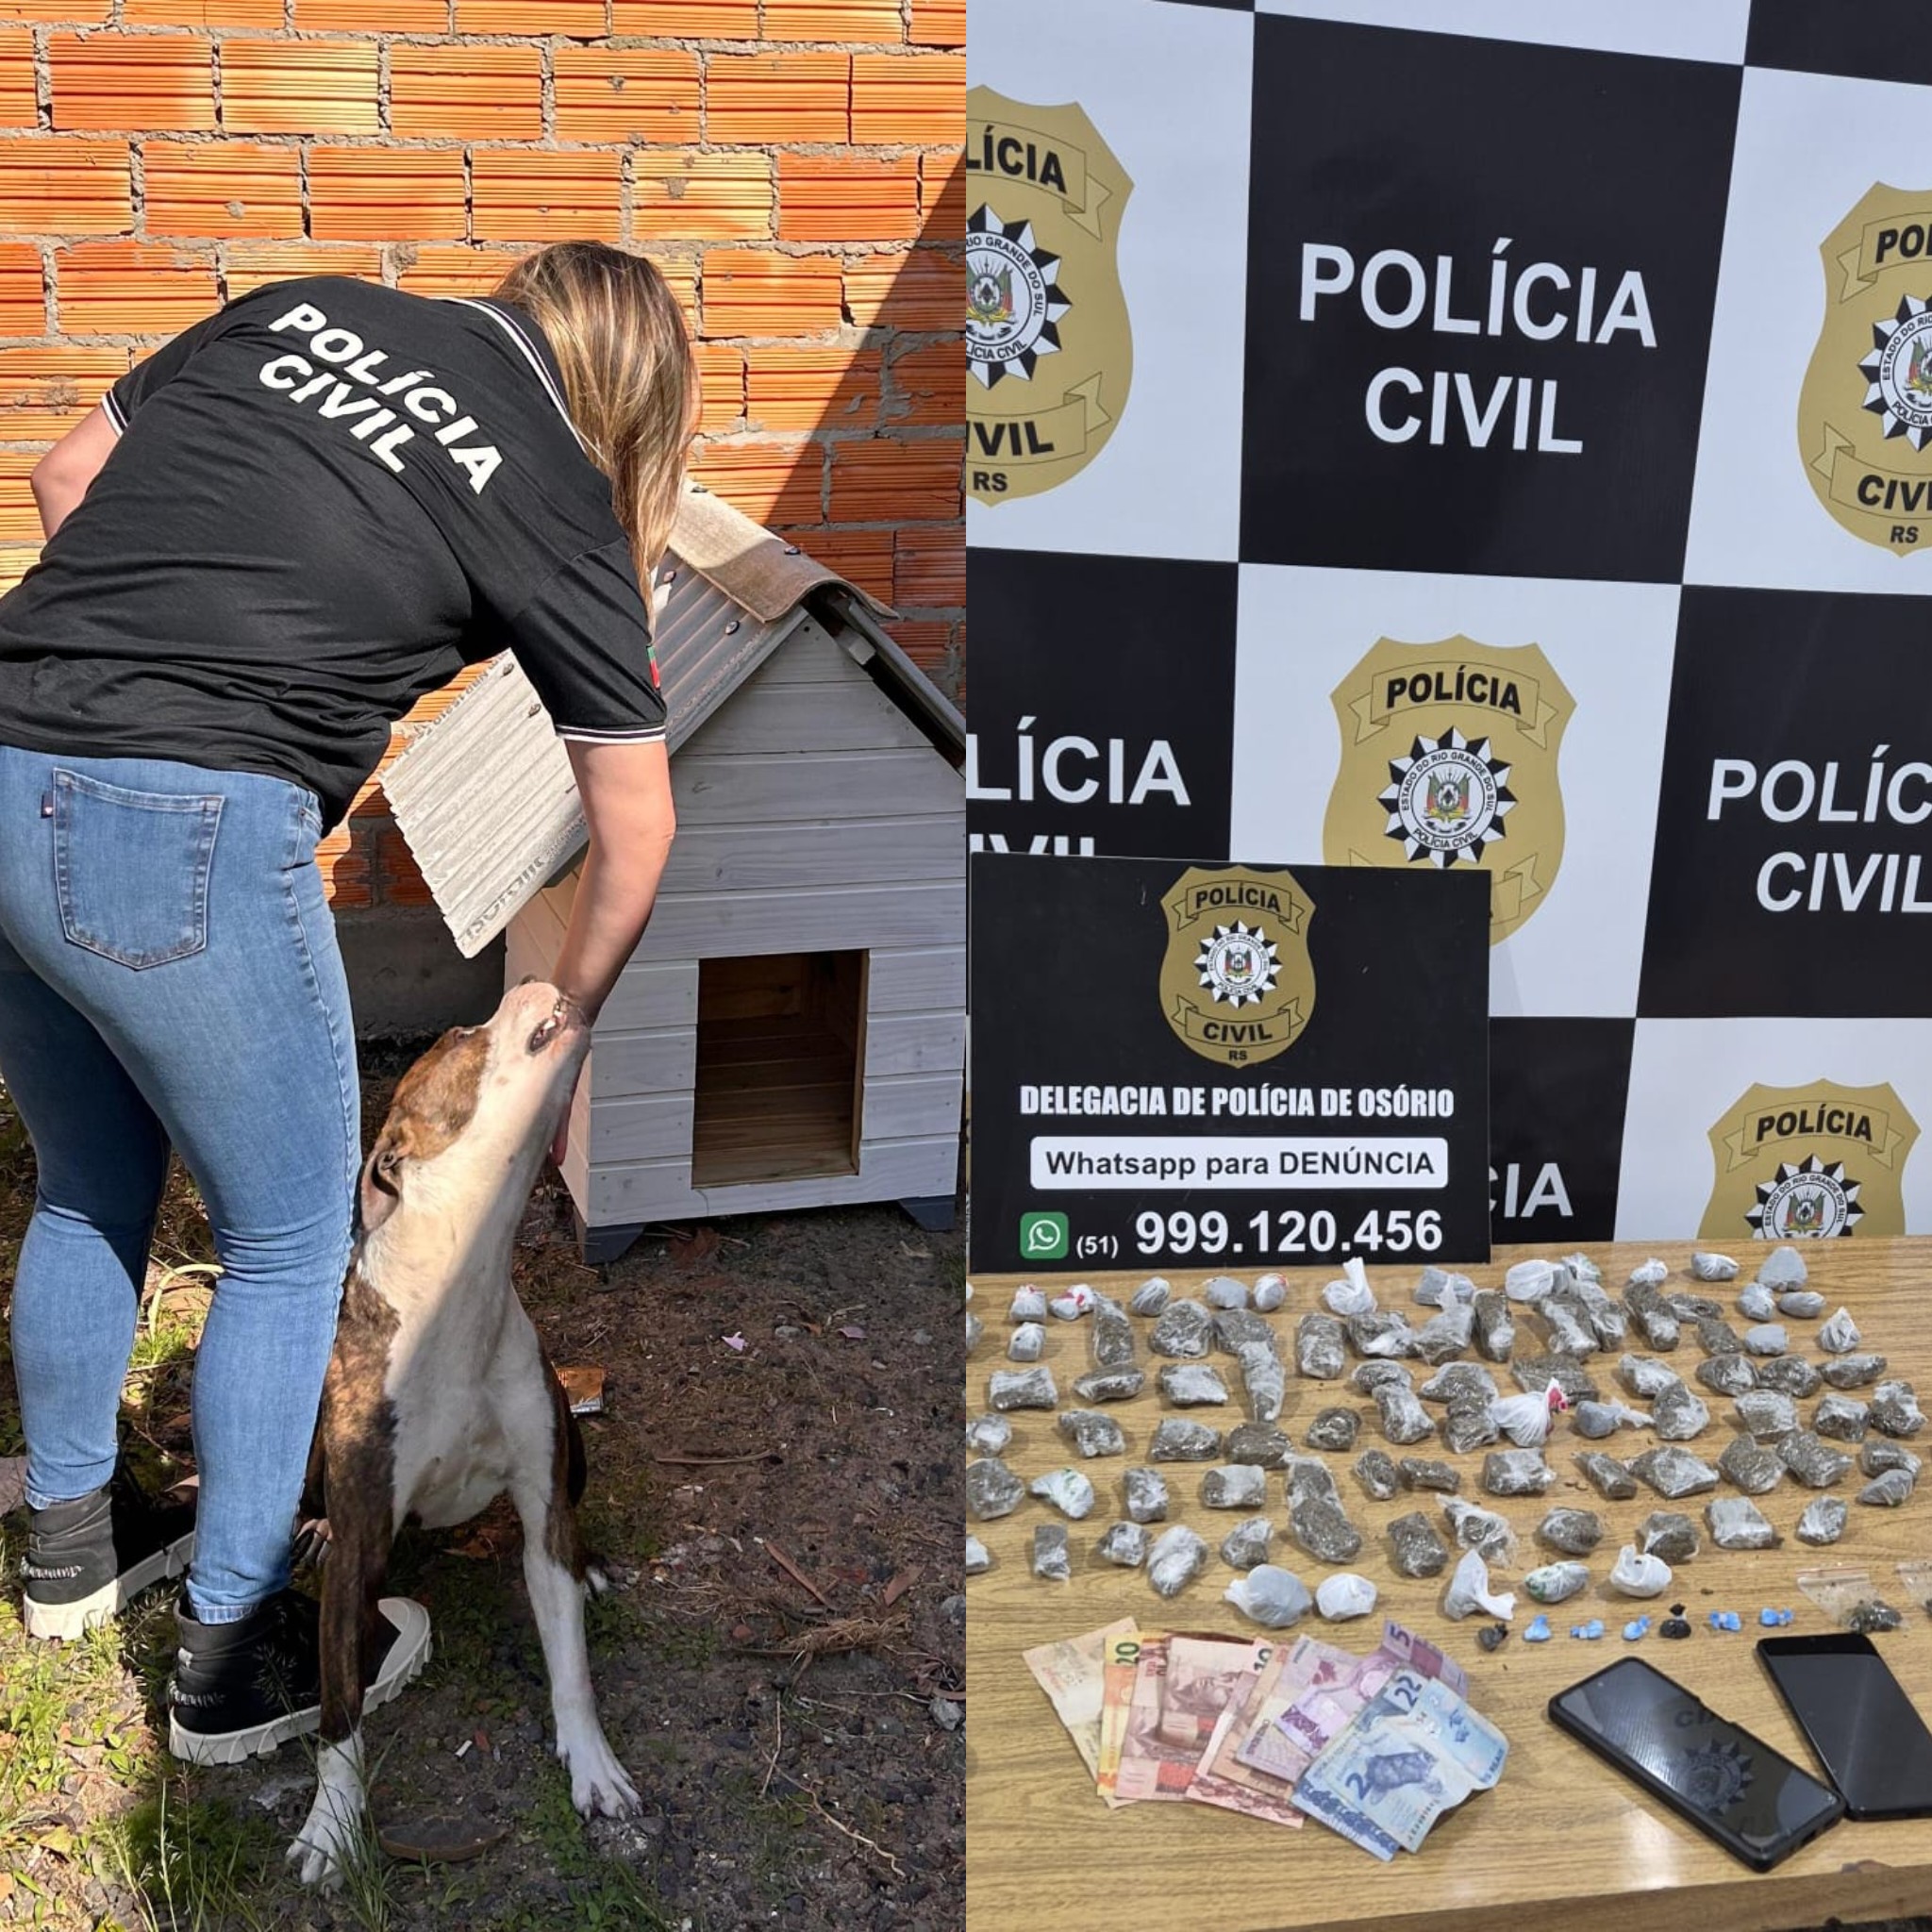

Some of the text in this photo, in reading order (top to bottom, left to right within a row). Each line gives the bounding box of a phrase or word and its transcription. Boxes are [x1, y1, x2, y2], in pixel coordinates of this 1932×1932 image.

[966, 124, 1067, 194] LÍCIA
[986, 237, 1031, 269] GRANDE
[1028, 271, 1040, 289] DO
[1034, 293, 1043, 316] SUL
[1300, 237, 1657, 348] POLÍCIA
[997, 341, 1027, 358] CIVIL
[1882, 337, 1901, 381] ESTADO
[1900, 323, 1916, 337] DO
[259, 354, 415, 473] CIVIL
[268, 302, 503, 495] POLÍCIA
[1365, 367, 1584, 454] CIVIL
[1891, 401, 1929, 425] POLÍCIA
[973, 470, 1008, 492] RS
[1890, 525, 1919, 543] RS
[1386, 664, 1522, 716] POLÍCIA
[966, 715, 1191, 806] LÍCIA
[1401, 772, 1418, 811] ESTADO
[1415, 759, 1429, 773] DO
[1430, 751, 1448, 763] RIO
[1450, 751, 1487, 775] GRANDE
[1483, 776, 1493, 791] DO
[1707, 743, 1932, 824] POLÍC
[1412, 827, 1478, 848] POLÍCIA CIVIL
[1195, 882, 1281, 912] POLÍCIA
[1757, 851, 1932, 913] CIVIL
[1203, 1023, 1273, 1042] CIVIL
[1228, 1050, 1248, 1061] RS
[1020, 1082, 1455, 1118] DELEGACIA DE POLÍCIA DE OSÓRIO
[1756, 1103, 1873, 1141] POLÍCIA
[1045, 1145, 1435, 1180] Whatsapp para DENÚNCIA
[1489, 1162, 1574, 1218] IA
[1075, 1209, 1442, 1259] (51) 999.120.456
